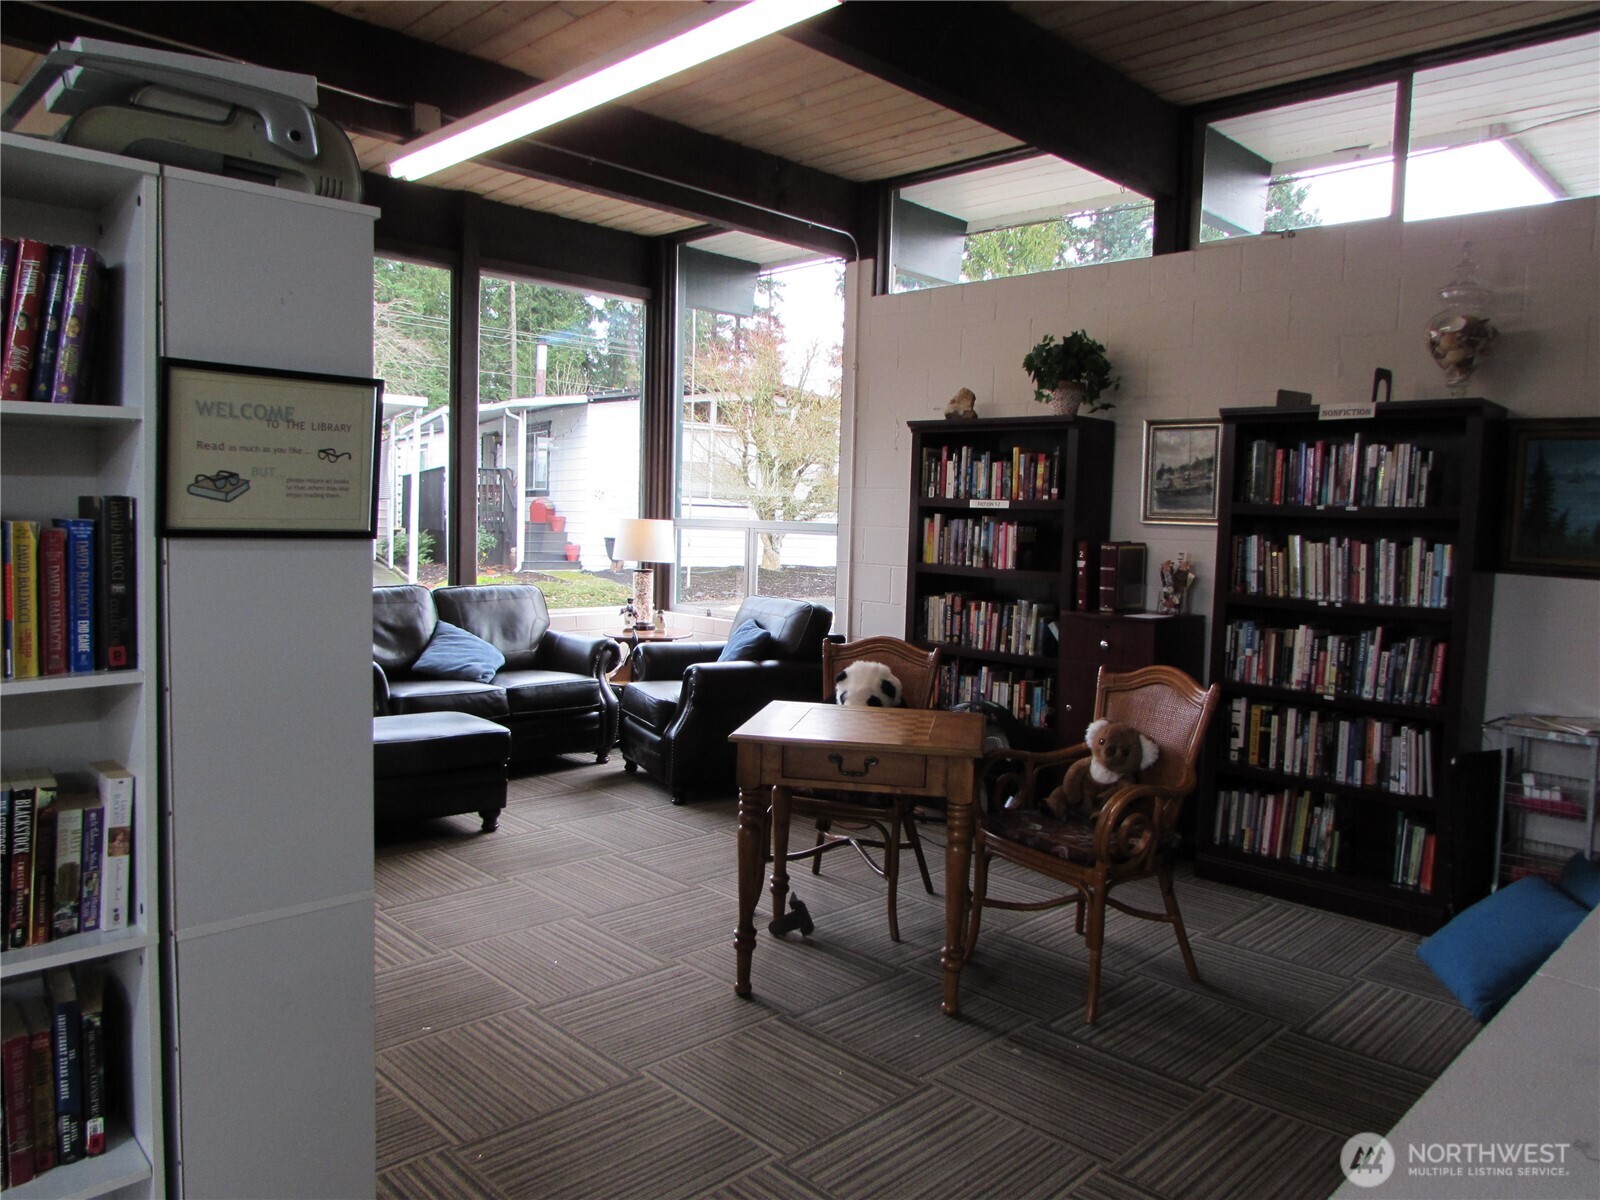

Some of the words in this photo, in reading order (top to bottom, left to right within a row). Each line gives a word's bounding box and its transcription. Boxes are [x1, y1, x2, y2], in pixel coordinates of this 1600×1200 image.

[194, 400, 296, 422] WELCOME
[1322, 408, 1371, 417] NONFICTION
[266, 419, 280, 429] TO
[286, 420, 306, 430] THE
[312, 422, 352, 432] LIBRARY
[196, 440, 225, 451] Read
[273, 447, 287, 455] you
[110, 501, 124, 530] DAVID
[16, 544, 29, 572] DAVID
[75, 540, 88, 569] DAVID
[110, 533, 126, 579] BALDACCI
[48, 565, 60, 597] DAVID
[76, 571, 89, 616] BALDACCI
[16, 576, 30, 623] BALDACCI
[48, 600, 61, 650] BALDACCI
[77, 620, 88, 633] END
[77, 634, 90, 652] GAME
[12, 798, 31, 854] BLACKSTOCK
[56, 1013, 67, 1055] INDIFFERENT
[59, 1057, 68, 1077] STARS
[59, 1080, 69, 1100] ABOVE
